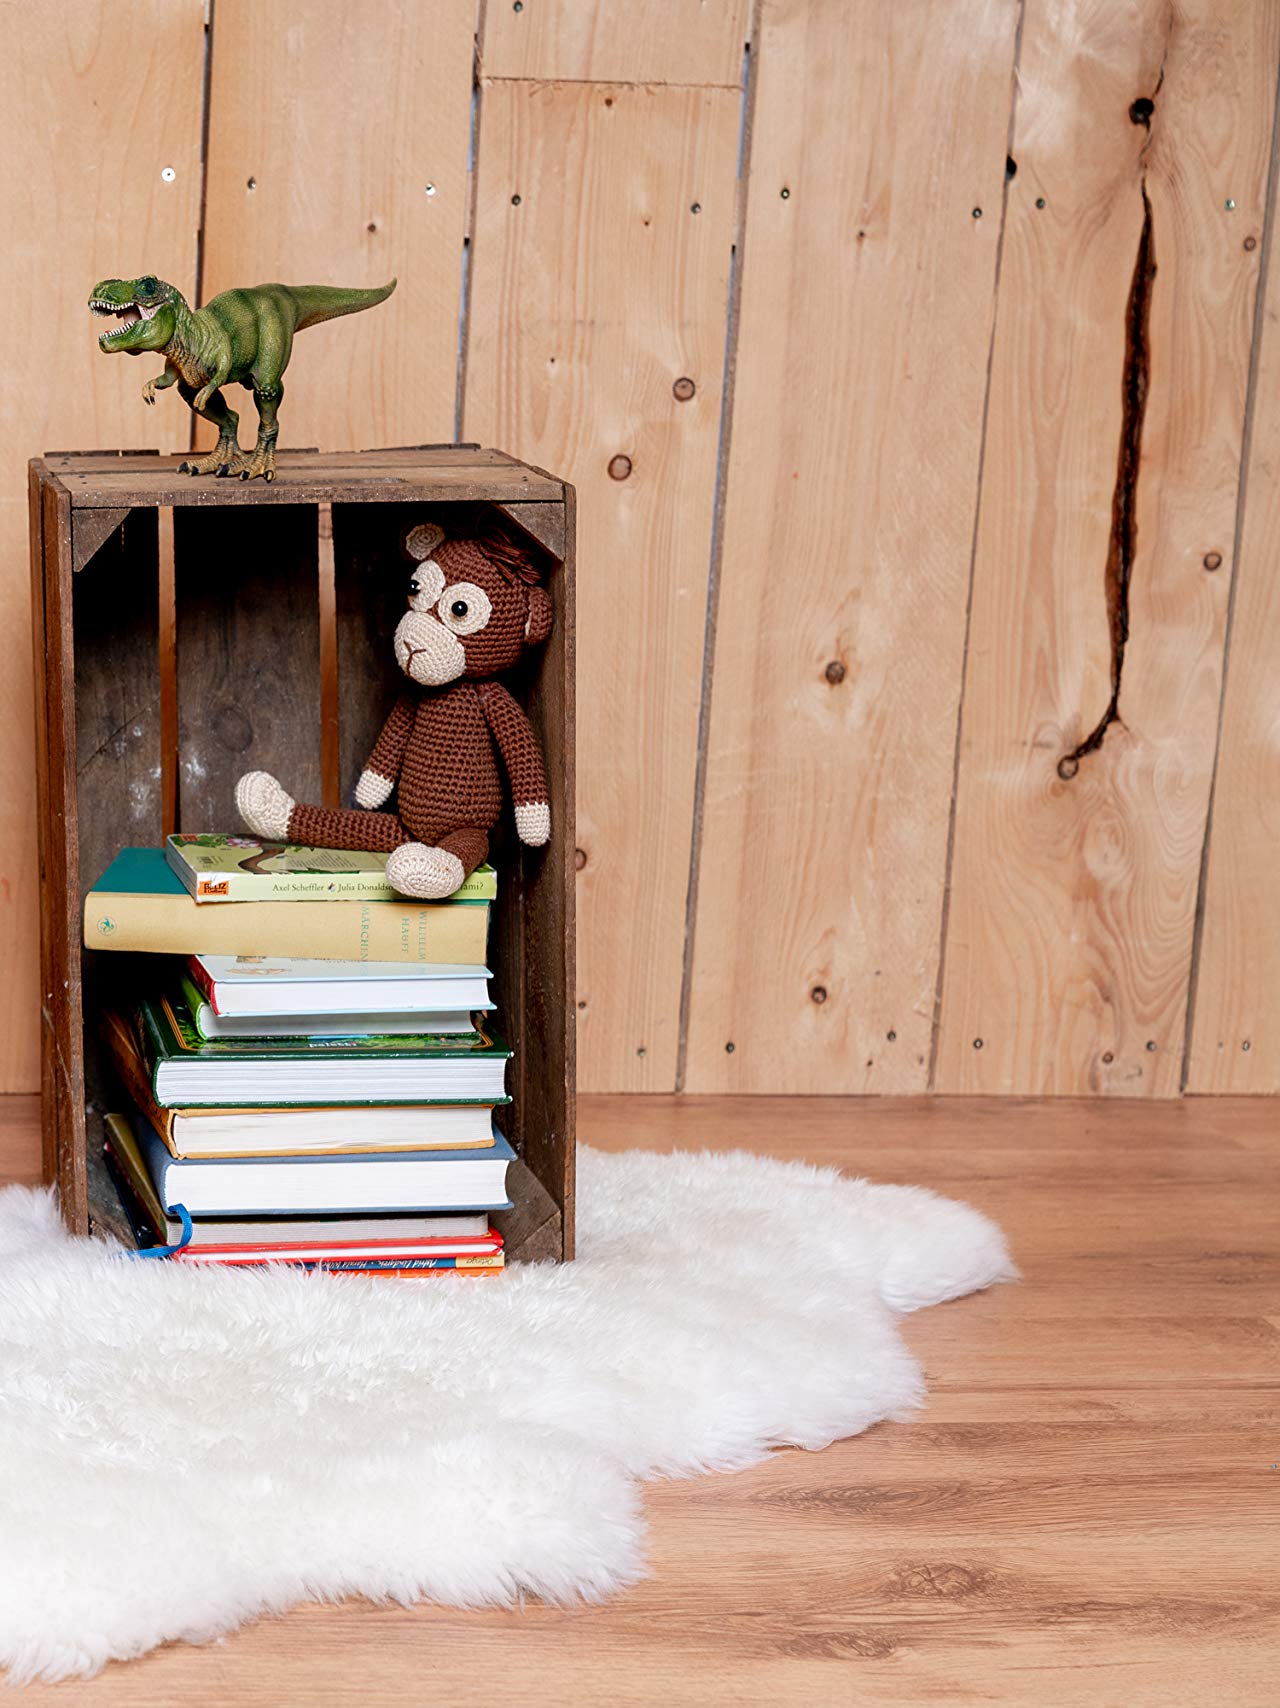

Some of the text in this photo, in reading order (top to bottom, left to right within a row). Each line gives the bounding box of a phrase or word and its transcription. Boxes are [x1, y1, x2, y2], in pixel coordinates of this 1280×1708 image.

[272, 880, 484, 893] Axel Scheffler Julia Donaldso ami?
[378, 1259, 413, 1269] Lindgren
[412, 1258, 438, 1268] Astrid
